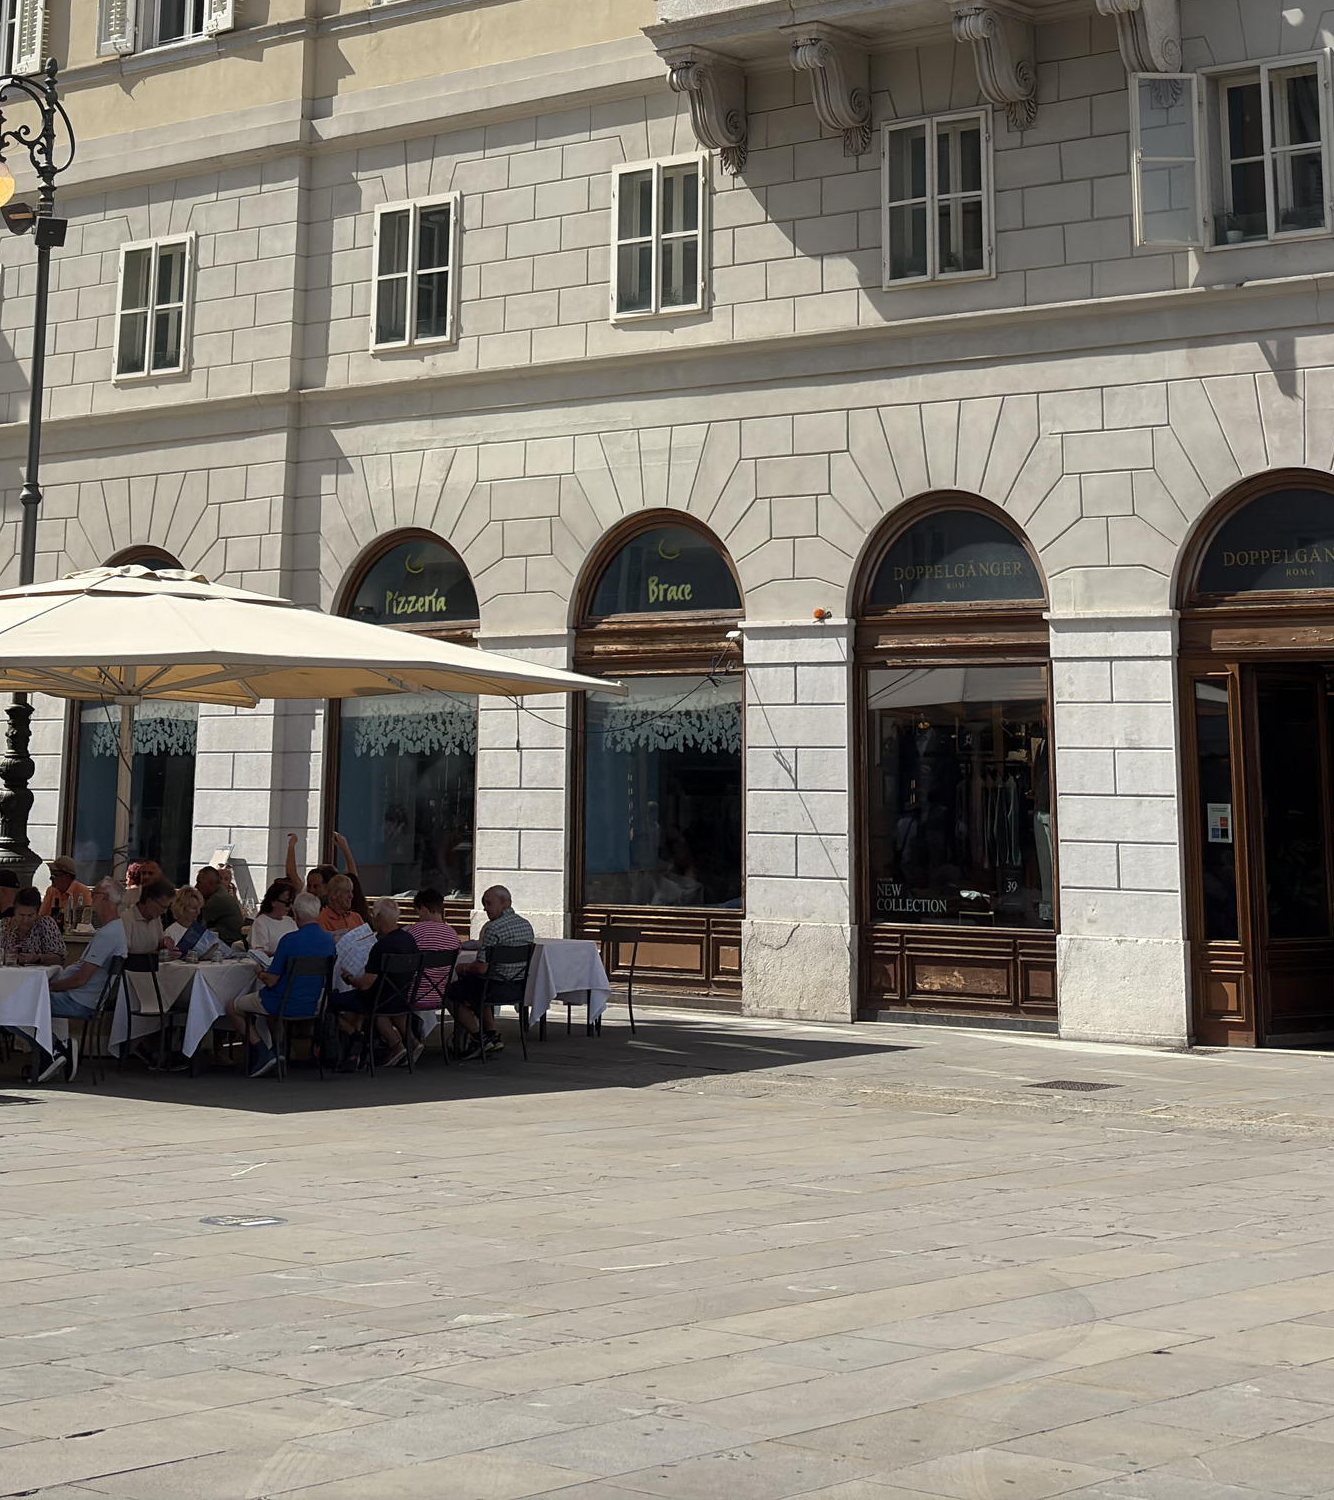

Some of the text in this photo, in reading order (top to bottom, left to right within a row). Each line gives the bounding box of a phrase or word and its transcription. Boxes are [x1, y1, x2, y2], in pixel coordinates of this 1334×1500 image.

[893, 560, 1023, 581] DOPPELGÄNGER
[1286, 567, 1316, 577] ROMA
[648, 575, 693, 604] Brace
[385, 588, 447, 615] Pizzeria
[876, 883, 904, 897] NEW
[876, 898, 948, 913] COLLECTION
